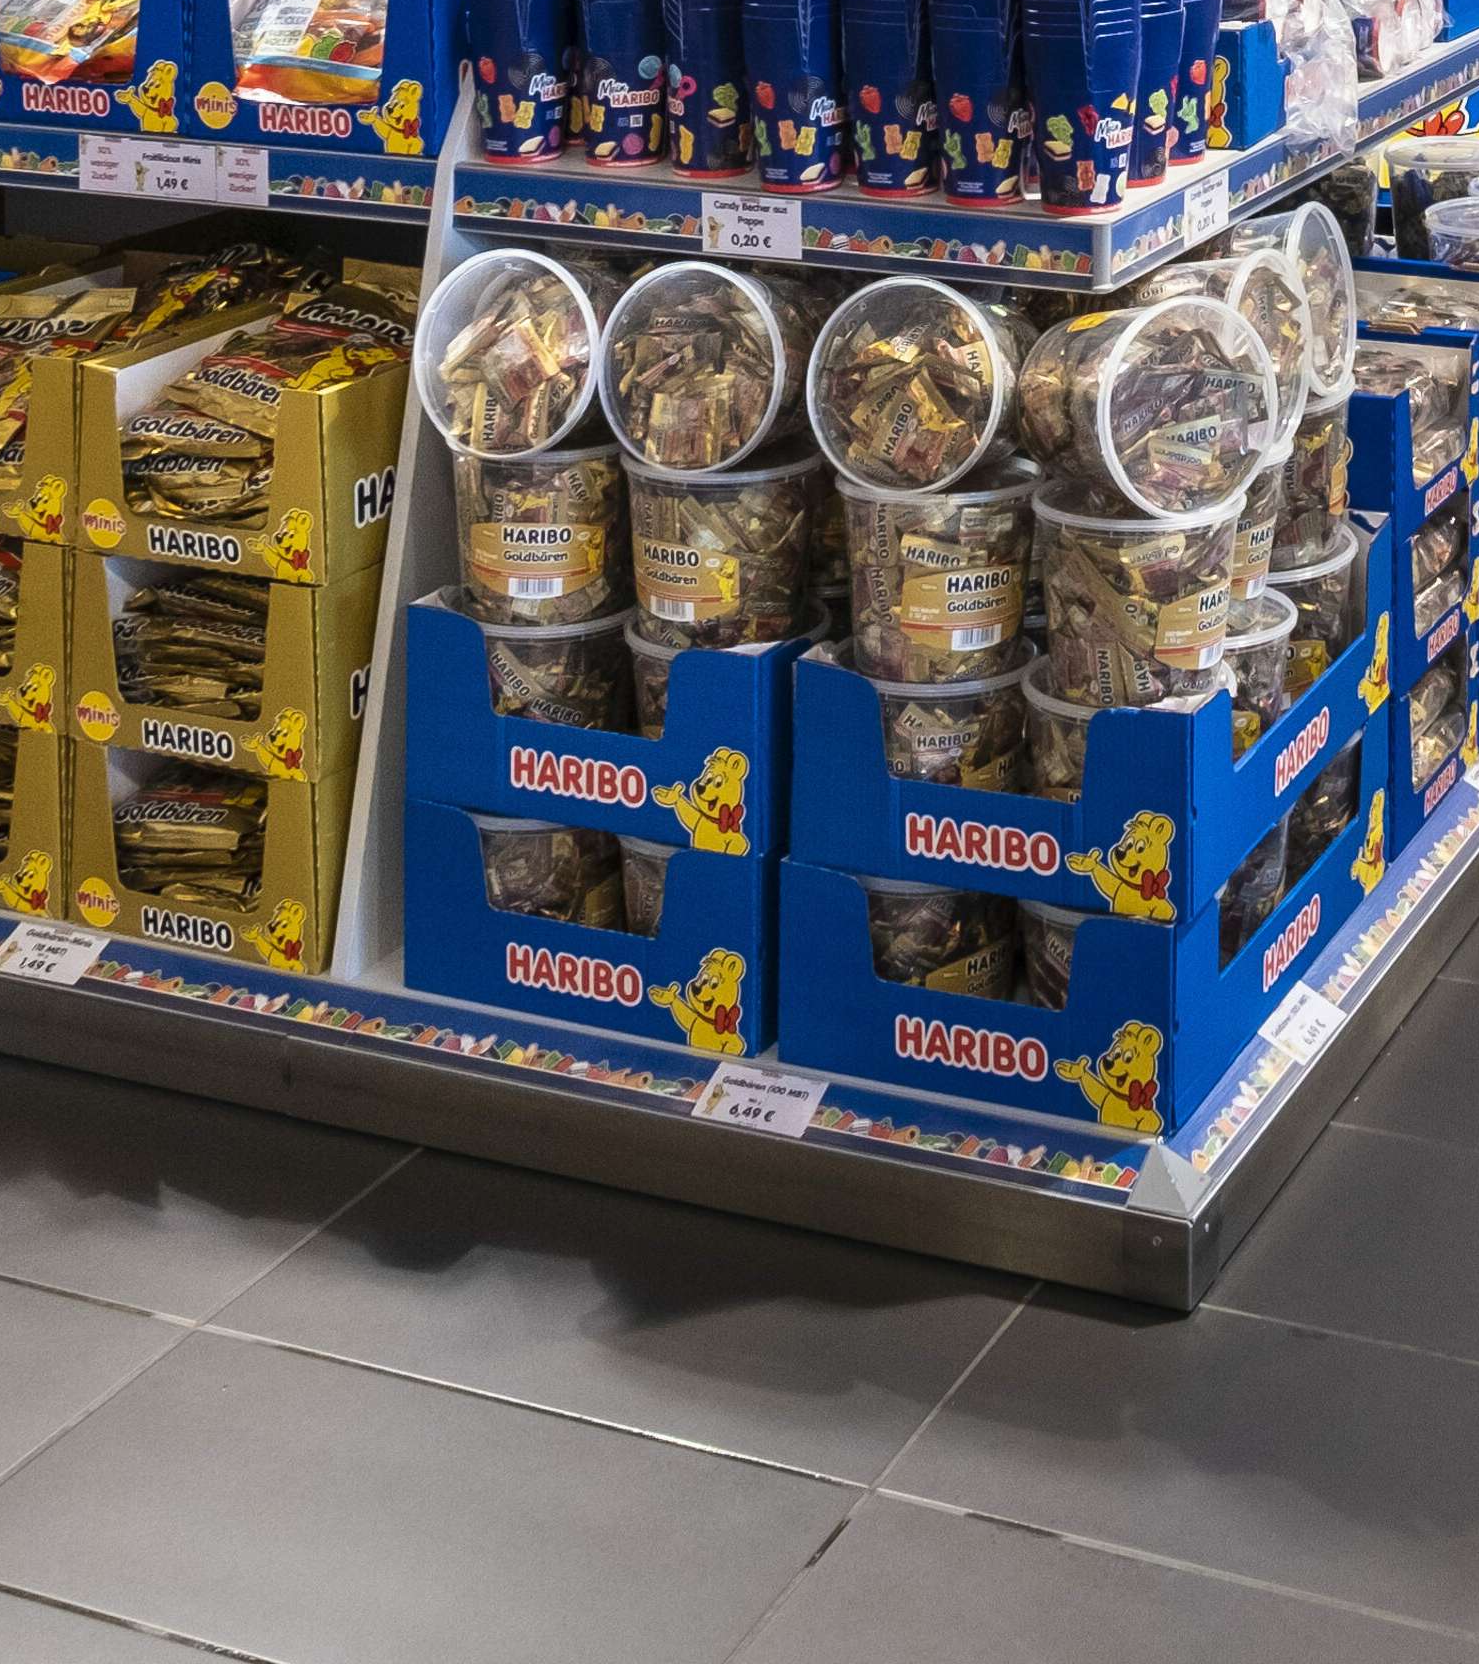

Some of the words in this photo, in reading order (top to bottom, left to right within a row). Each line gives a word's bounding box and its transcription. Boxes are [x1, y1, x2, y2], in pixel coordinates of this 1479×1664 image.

[22, 84, 111, 116] HARIBO
[599, 79, 629, 98] Mein
[611, 90, 660, 107] HARIBO
[195, 95, 239, 116] minis
[259, 104, 353, 137] HARIBO
[156, 177, 178, 190] 1,49
[180, 178, 189, 190] €
[713, 200, 741, 212] Candy
[742, 202, 772, 213] Becher
[737, 215, 764, 227] Pappe
[730, 234, 759, 248] 0,20
[763, 236, 772, 249] €
[130, 411, 247, 445] Goldbären
[884, 400, 915, 458] HARIBO
[82, 512, 126, 536] minis
[148, 526, 241, 564] HARIBO
[501, 526, 572, 546] HARIBO
[503, 548, 568, 565] Goldbären
[642, 544, 700, 568] HARIBO
[642, 566, 698, 588] Goldbären
[946, 569, 1013, 594] HARIBO
[946, 593, 1008, 615] Goldbären
[143, 718, 234, 762] HARIBO
[916, 732, 972, 749] HARIBO
[1273, 706, 1330, 796] HARIBO
[509, 746, 647, 807] HARIBO
[1424, 758, 1457, 816] HARIBO
[906, 813, 1060, 875] HARIBO
[76, 890, 120, 913] minis
[142, 905, 233, 950] HARIBO
[20, 957, 44, 971] 1,49
[45, 962, 57, 974] €
[896, 1014, 1047, 1081] HARIBO
[729, 1103, 762, 1119] 6,49
[763, 1109, 777, 1123] €
